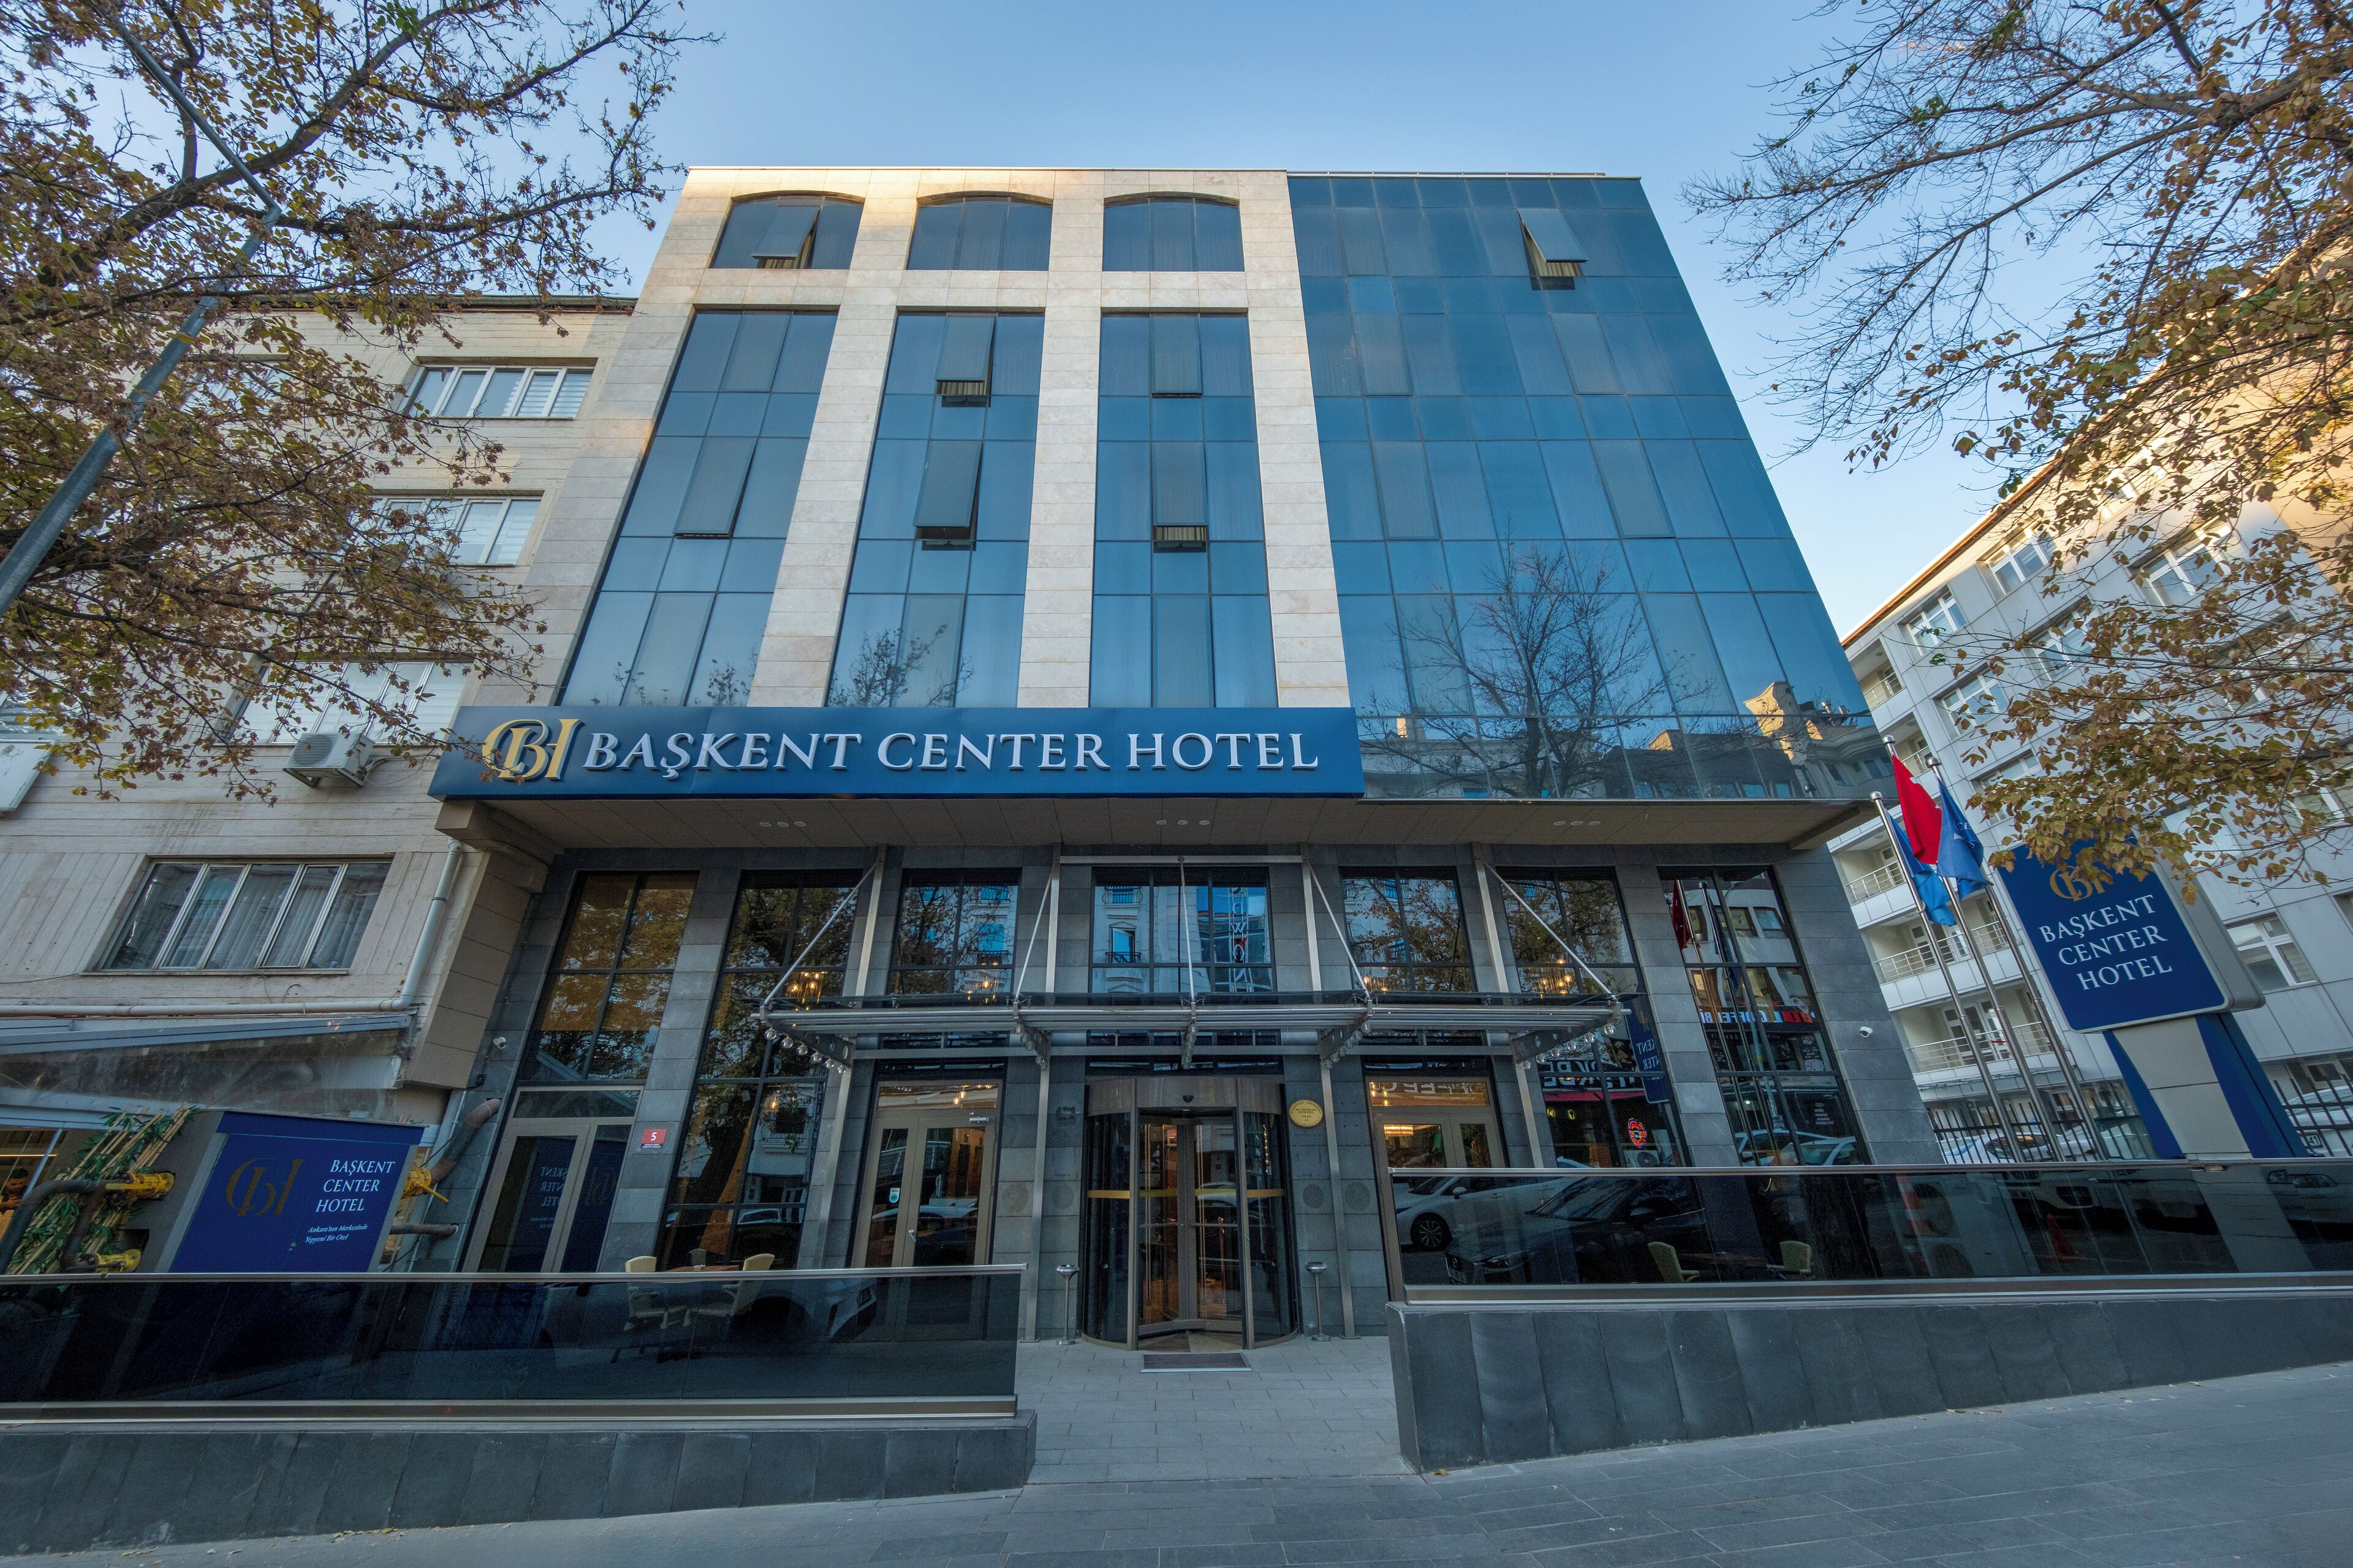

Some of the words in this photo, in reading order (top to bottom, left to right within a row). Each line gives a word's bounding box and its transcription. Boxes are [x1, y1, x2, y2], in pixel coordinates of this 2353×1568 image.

[582, 733, 862, 779] BAŞKENT
[877, 733, 1111, 770] CENTER
[1126, 733, 1318, 770] HOTEL
[2038, 894, 2156, 942] BAŞKENT
[2058, 925, 2168, 965] CENTER
[2076, 955, 2172, 990] HOTEL
[650, 1132, 657, 1141] 5
[330, 1159, 395, 1176] BAŞKENT
[323, 1179, 380, 1192] CENTER
[315, 1199, 365, 1213] HOTEL
[338, 1223, 368, 1232] Merkezinde
[305, 1235, 327, 1244] Yepyeni
